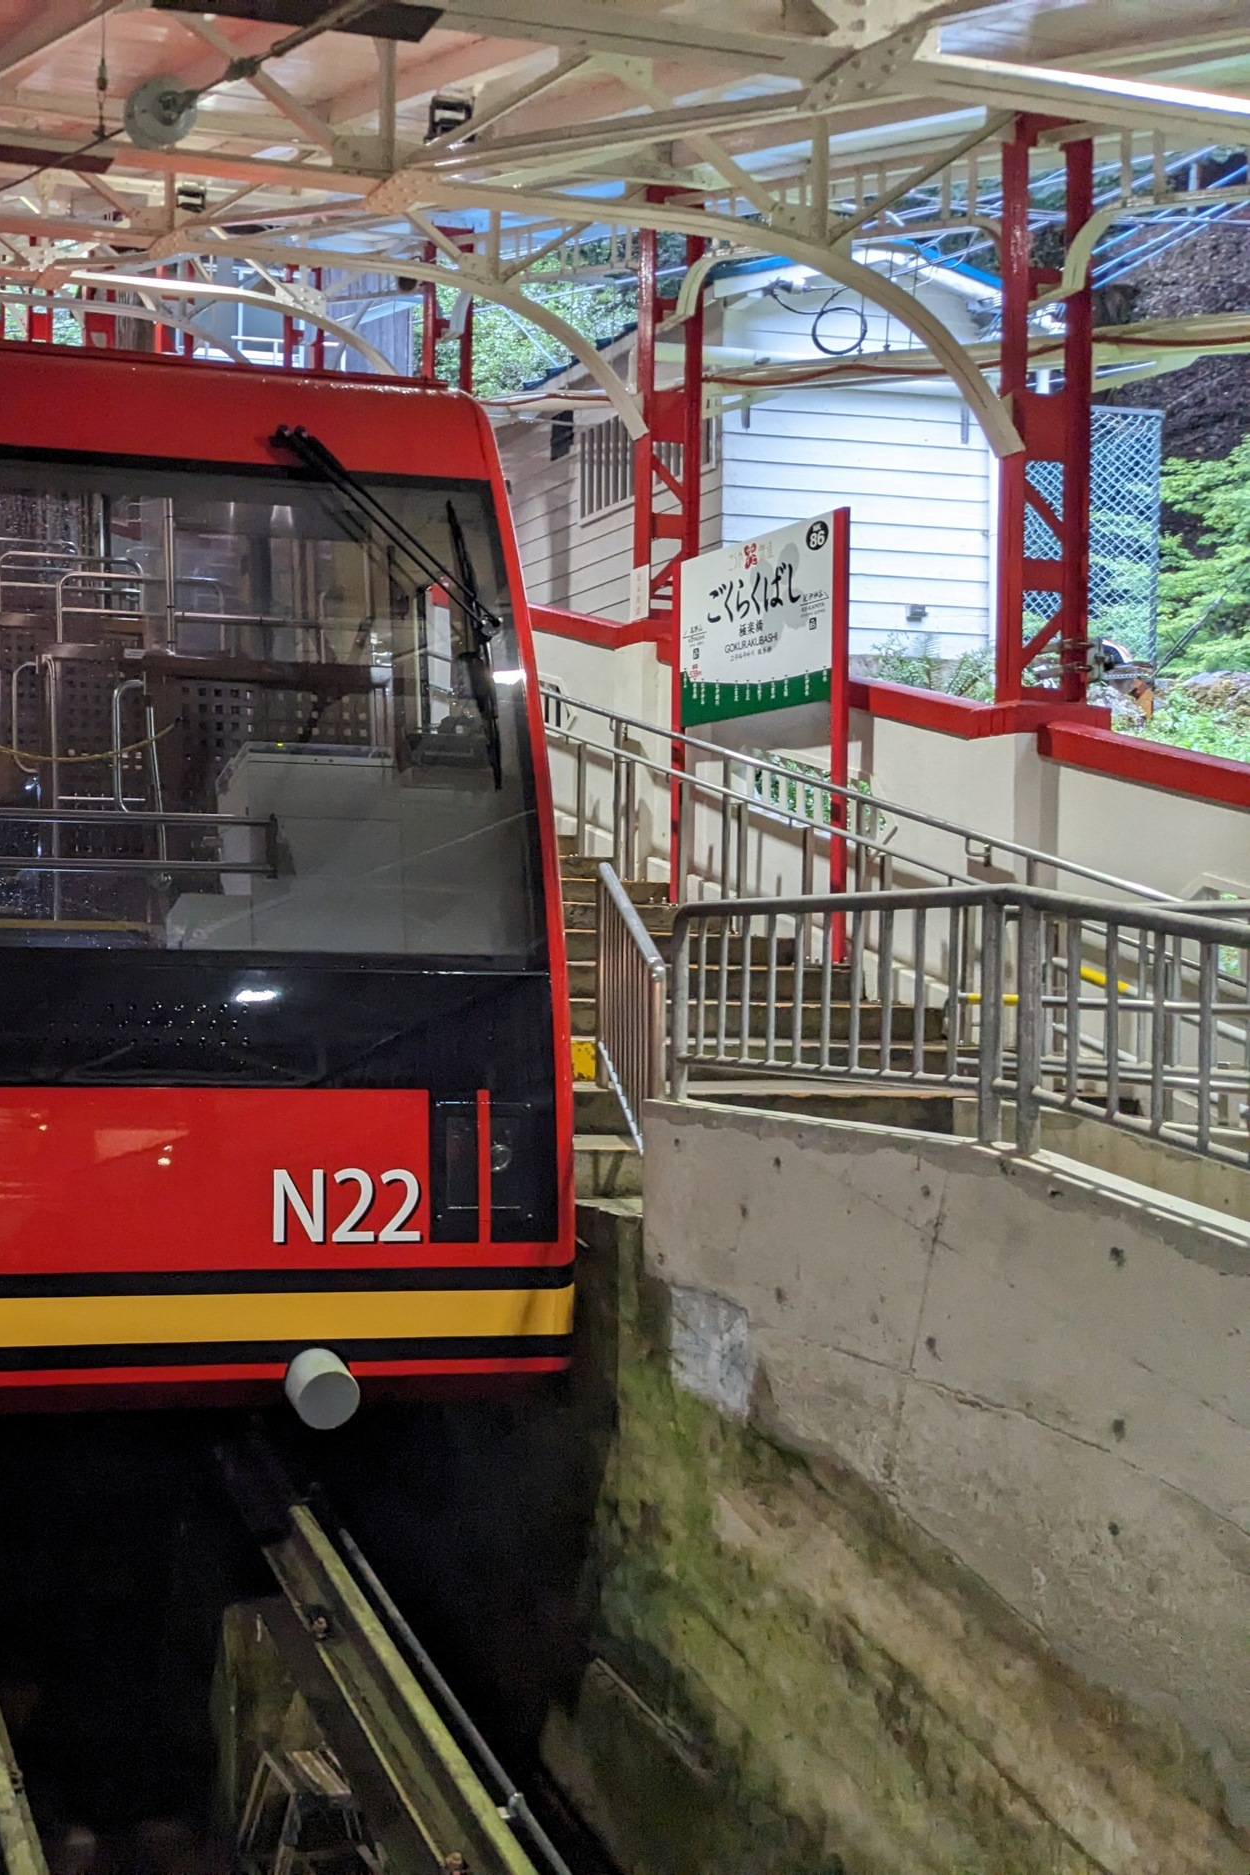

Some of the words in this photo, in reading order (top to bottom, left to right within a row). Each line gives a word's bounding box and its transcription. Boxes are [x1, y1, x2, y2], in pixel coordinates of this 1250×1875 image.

[809, 530, 825, 548] 86
[707, 562, 801, 623] ごくらくばし
[724, 632, 778, 653] GOKURAKUBASHI
[273, 1168, 421, 1243] N22
